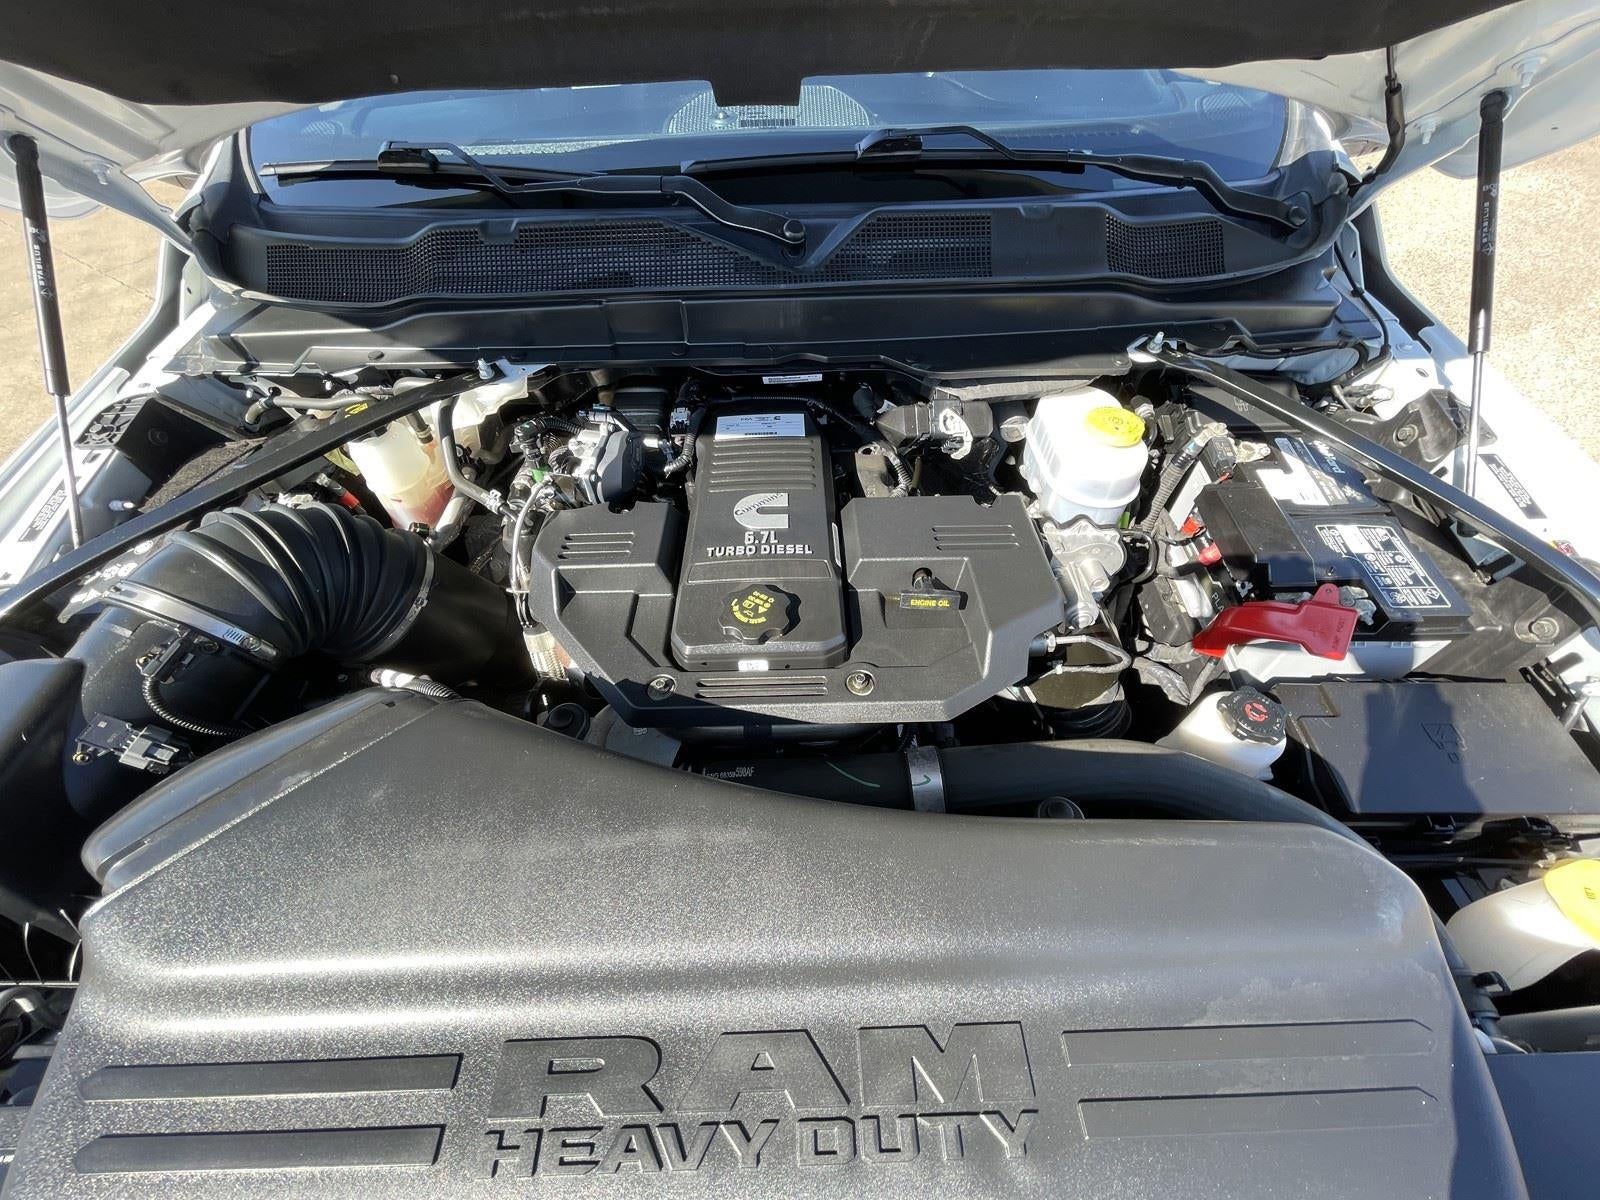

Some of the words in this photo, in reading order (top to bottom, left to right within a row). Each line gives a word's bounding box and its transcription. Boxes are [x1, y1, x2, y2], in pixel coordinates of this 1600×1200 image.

[744, 530, 779, 544] 6.7L
[706, 546, 756, 558] TURBO
[760, 544, 813, 555] DIESEL
[910, 598, 937, 607] ENGINE
[938, 599, 950, 607] OIL
[488, 1020, 1037, 1122] RAM
[476, 1118, 780, 1179] HEAVY
[797, 1109, 1039, 1168] DUTY
